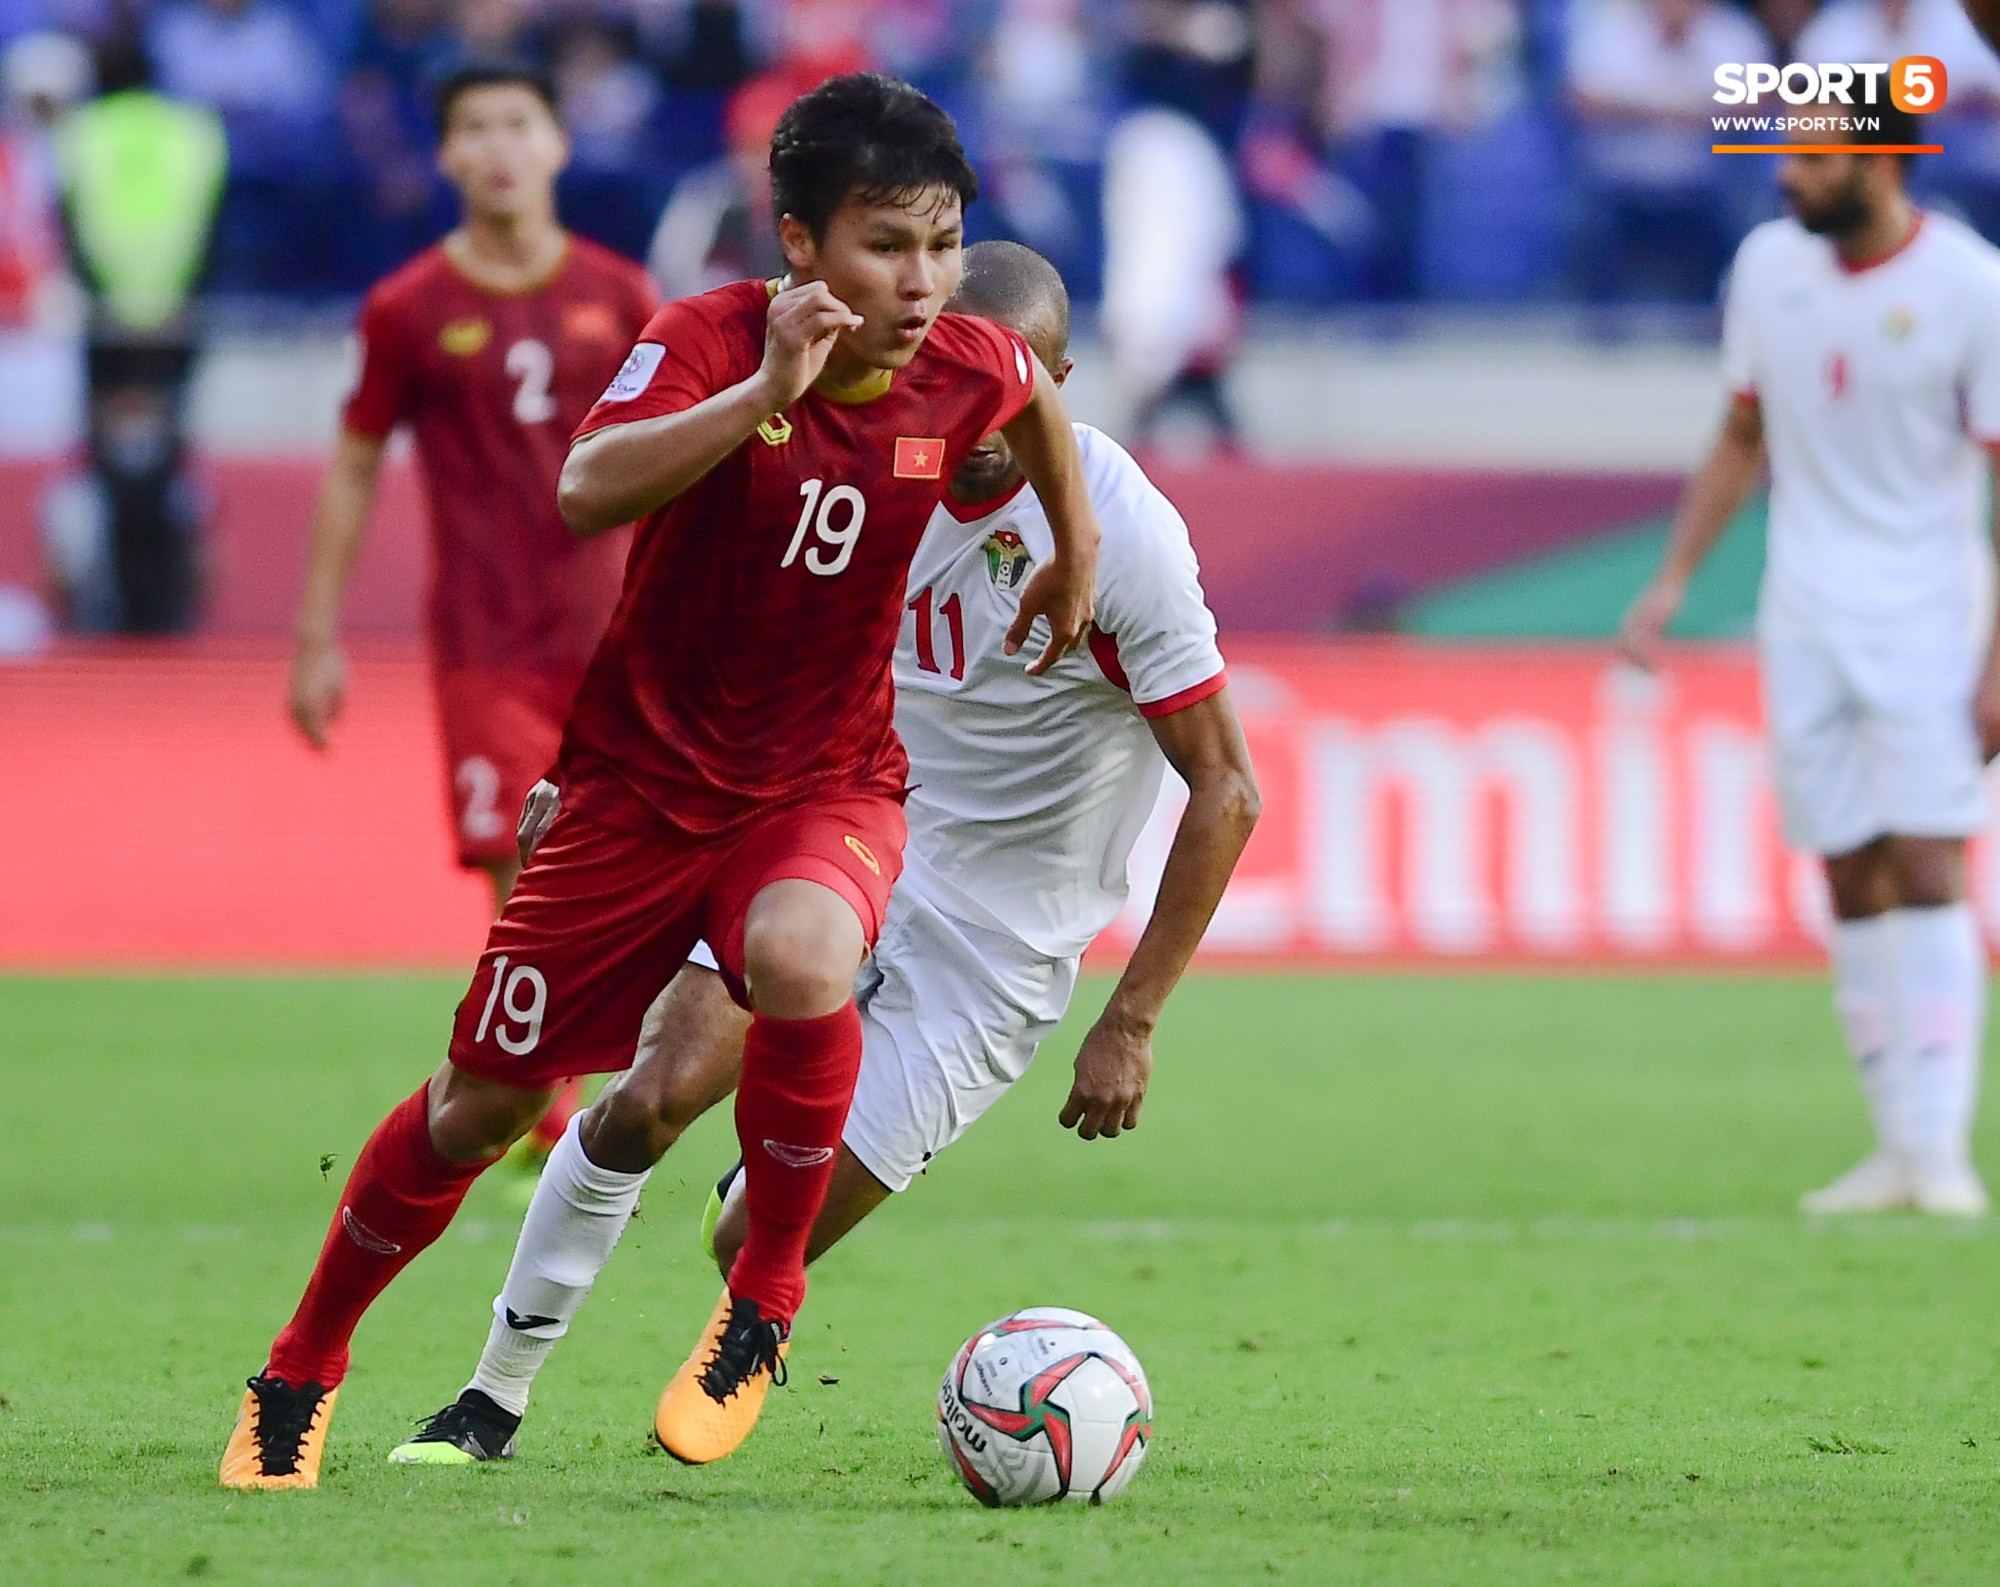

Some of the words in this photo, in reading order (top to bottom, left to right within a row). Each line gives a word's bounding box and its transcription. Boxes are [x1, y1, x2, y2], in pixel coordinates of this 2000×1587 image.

[505, 338, 556, 425] 2
[781, 478, 866, 576] 19
[907, 586, 965, 682] 11
[455, 755, 505, 840] 2
[475, 954, 547, 1056] 19
[942, 1372, 987, 1453] molten
